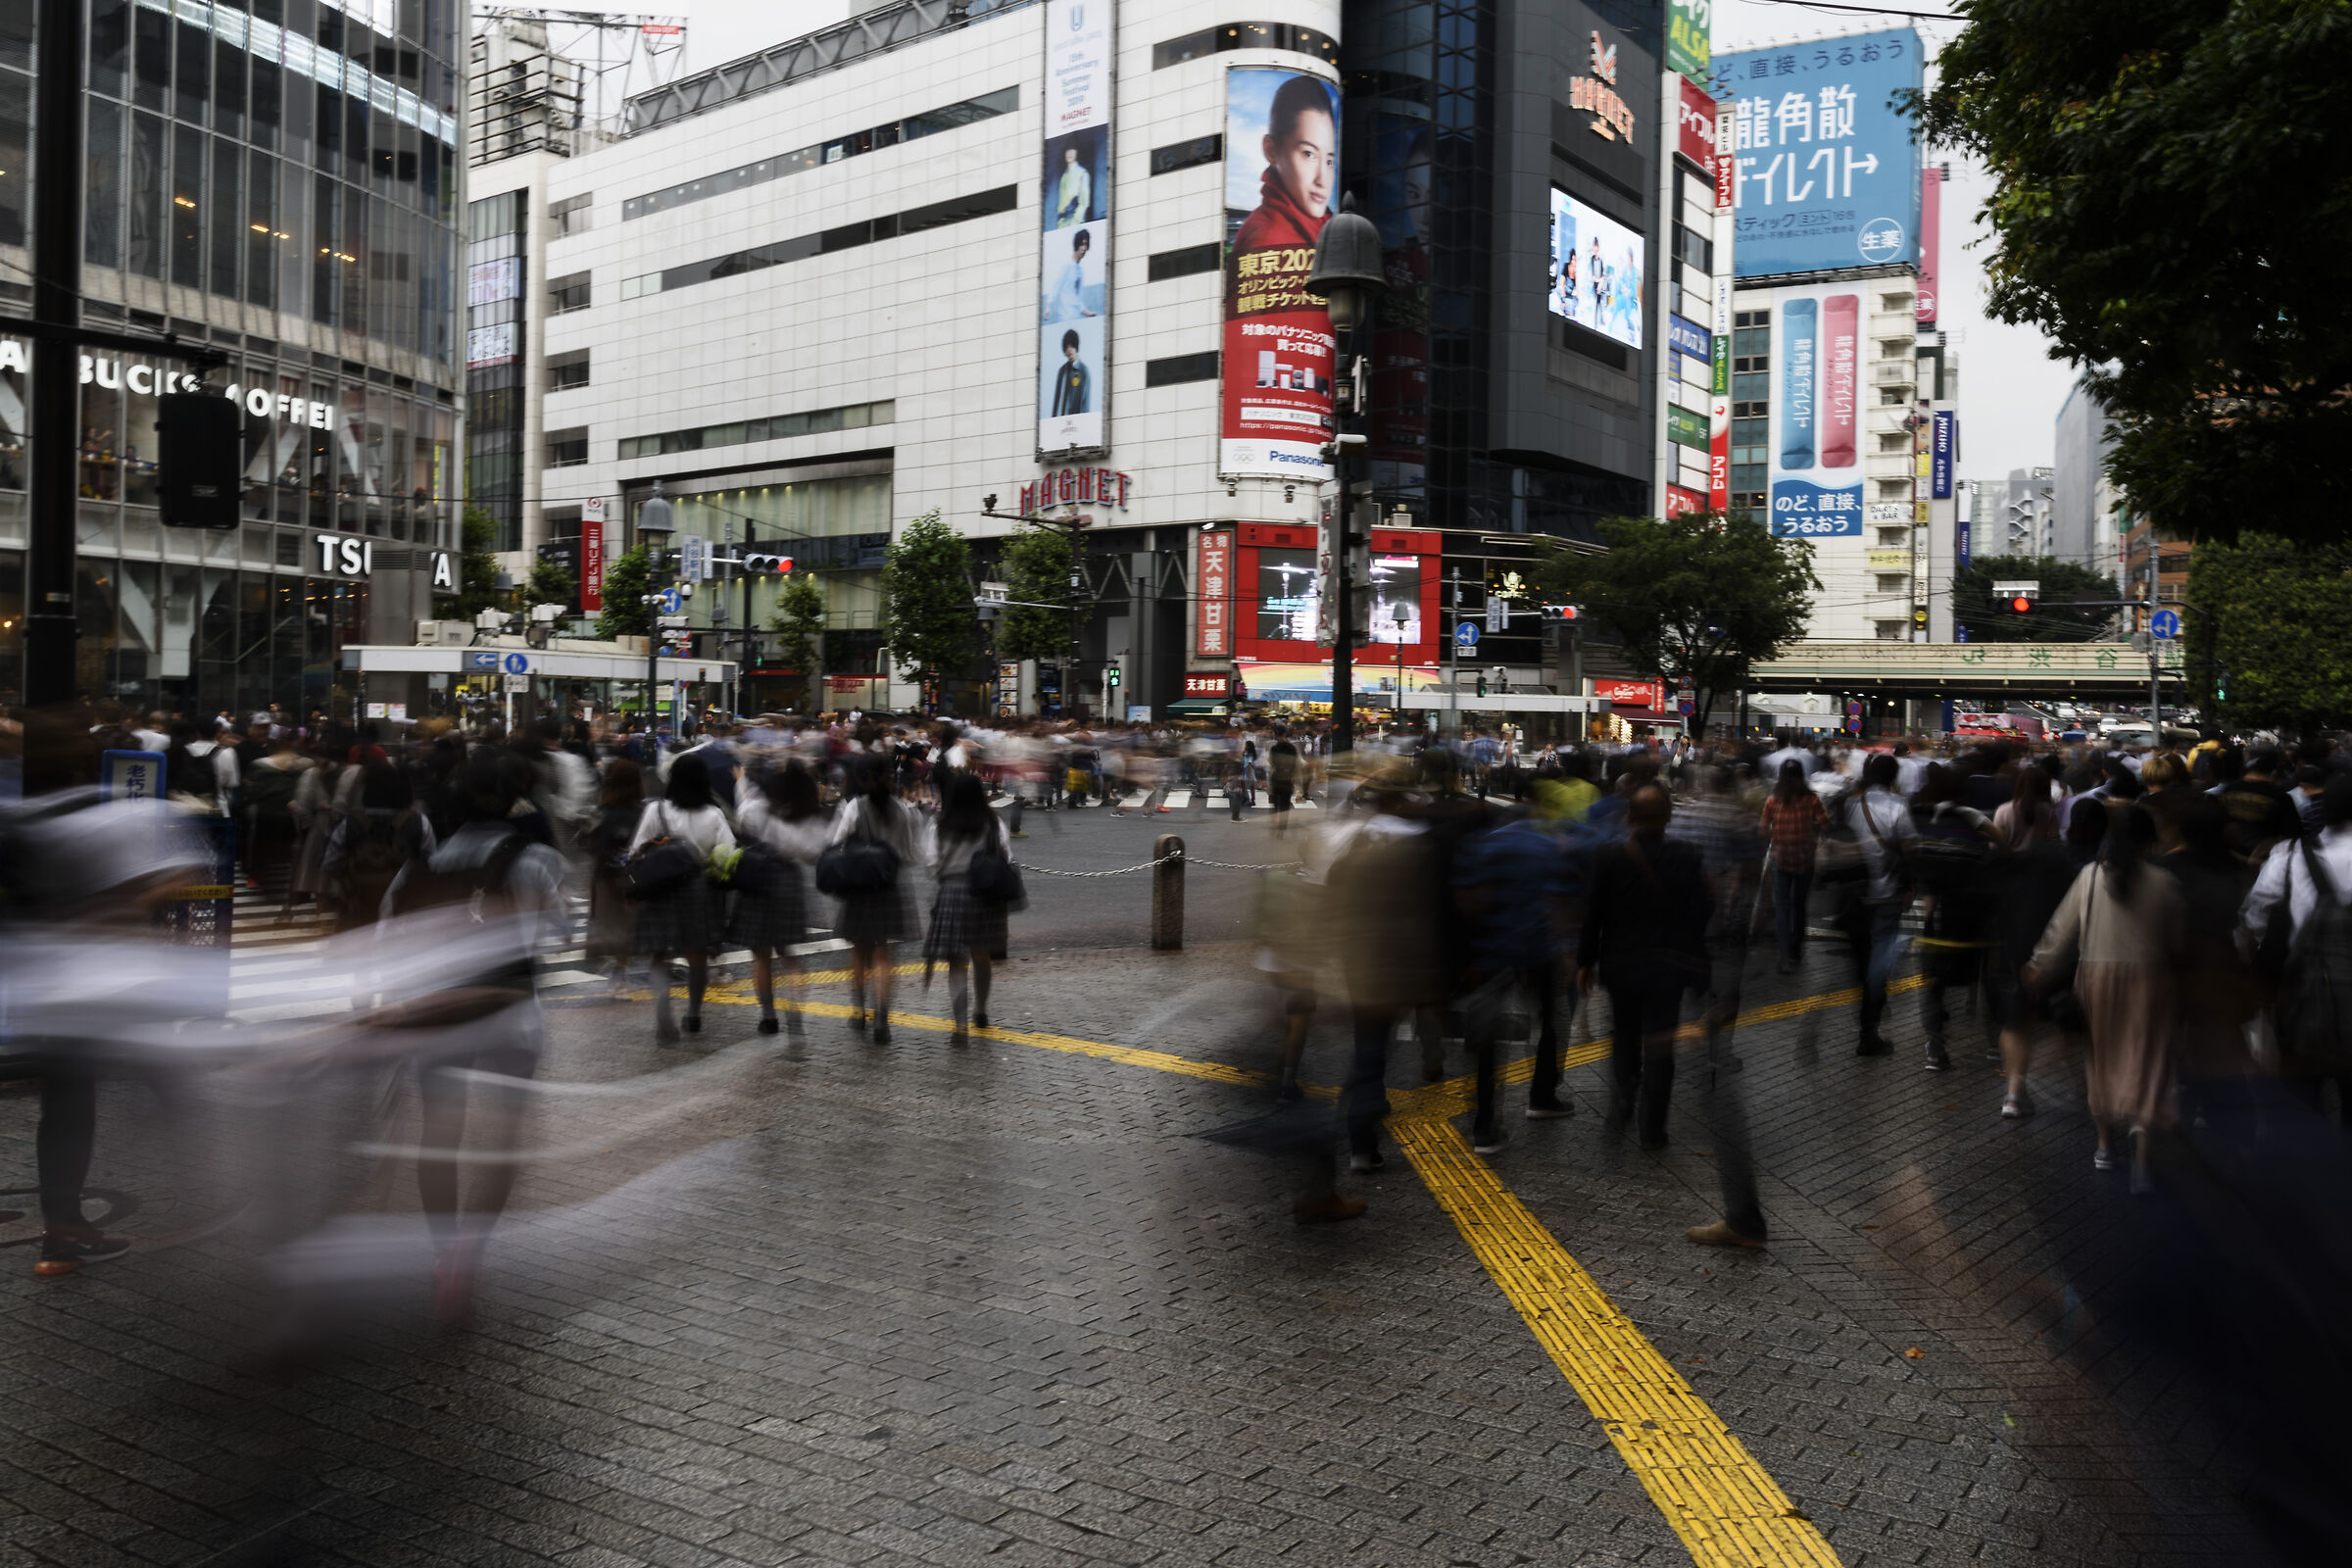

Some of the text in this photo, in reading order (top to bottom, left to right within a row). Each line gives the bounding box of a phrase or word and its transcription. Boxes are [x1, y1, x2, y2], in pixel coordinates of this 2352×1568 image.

[1718, 168, 1731, 207] アイフル
[1936, 416, 1948, 453] MIZUHO
[1712, 456, 1726, 490] アコム
[1020, 466, 1132, 518] MAGNET
[1783, 515, 1849, 534] うるおう
[1204, 551, 1223, 652] 天津甘栗
[1187, 678, 1226, 691] 天津甘栗
